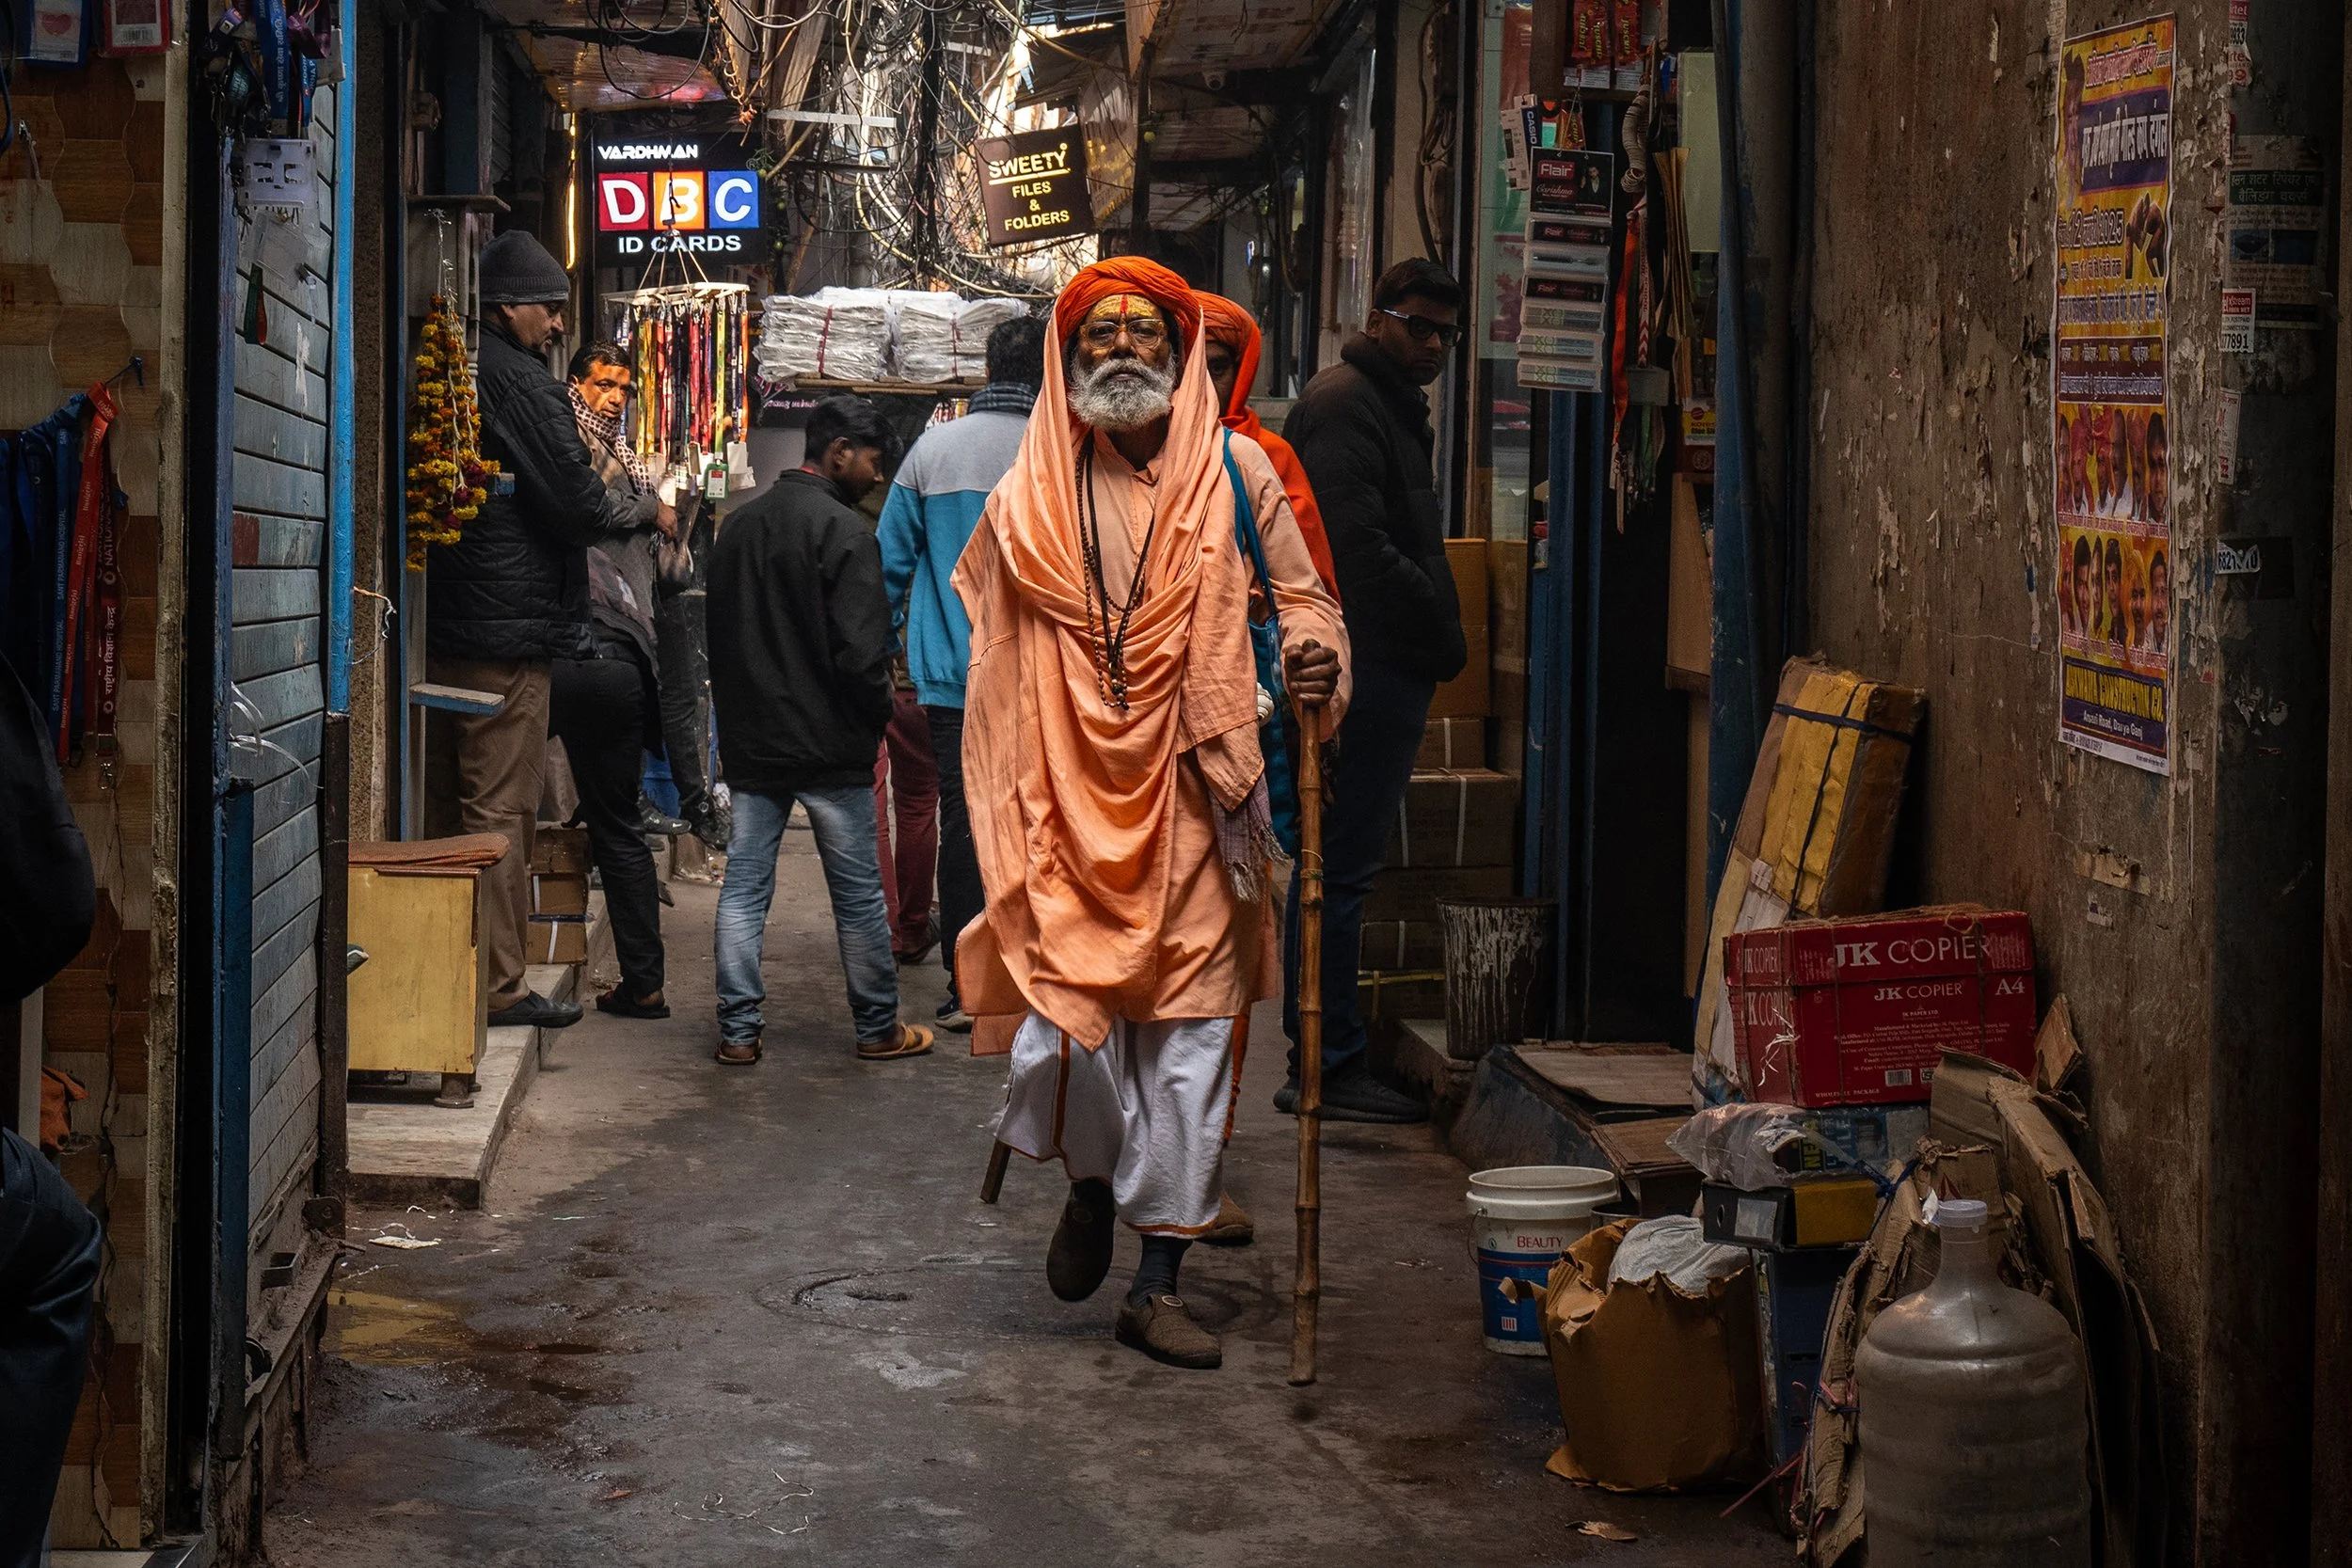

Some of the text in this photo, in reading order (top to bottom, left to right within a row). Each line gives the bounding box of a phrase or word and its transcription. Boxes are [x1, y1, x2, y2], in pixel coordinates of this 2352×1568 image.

[1526, 111, 1537, 144] CASIO
[597, 143, 698, 160] VARDHMAN
[988, 150, 1068, 179] SWEETY
[1540, 164, 1572, 177] Flair
[602, 178, 754, 225] DBC
[1011, 181, 1052, 198] FILES
[1028, 198, 1041, 212] &
[1004, 210, 1071, 231] FOLDERS
[2098, 209, 2124, 246] 2025
[618, 234, 741, 253] ID CARDS
[57, 509, 66, 540] HOSPITAL
[103, 504, 114, 566] NATIONAL
[56, 620, 64, 651] HOSPITAL
[103, 606, 117, 695] राष्ट्रीय विज्ञान केन्द्र
[2099, 673, 2150, 719] CONSTRUCTION
[2152, 685, 2164, 723] CO.
[2083, 710, 2144, 742] Ansari Road, Darya Ganj
[1743, 947, 1754, 974] JK
[1754, 946, 1779, 974] COPIER
[1827, 942, 1881, 968] JK
[1887, 935, 1991, 965] COPIER
[1873, 982, 1963, 1001] JK COPIER
[1994, 977, 2026, 997] A4
[1518, 1236, 1563, 1248] BEAUTY
